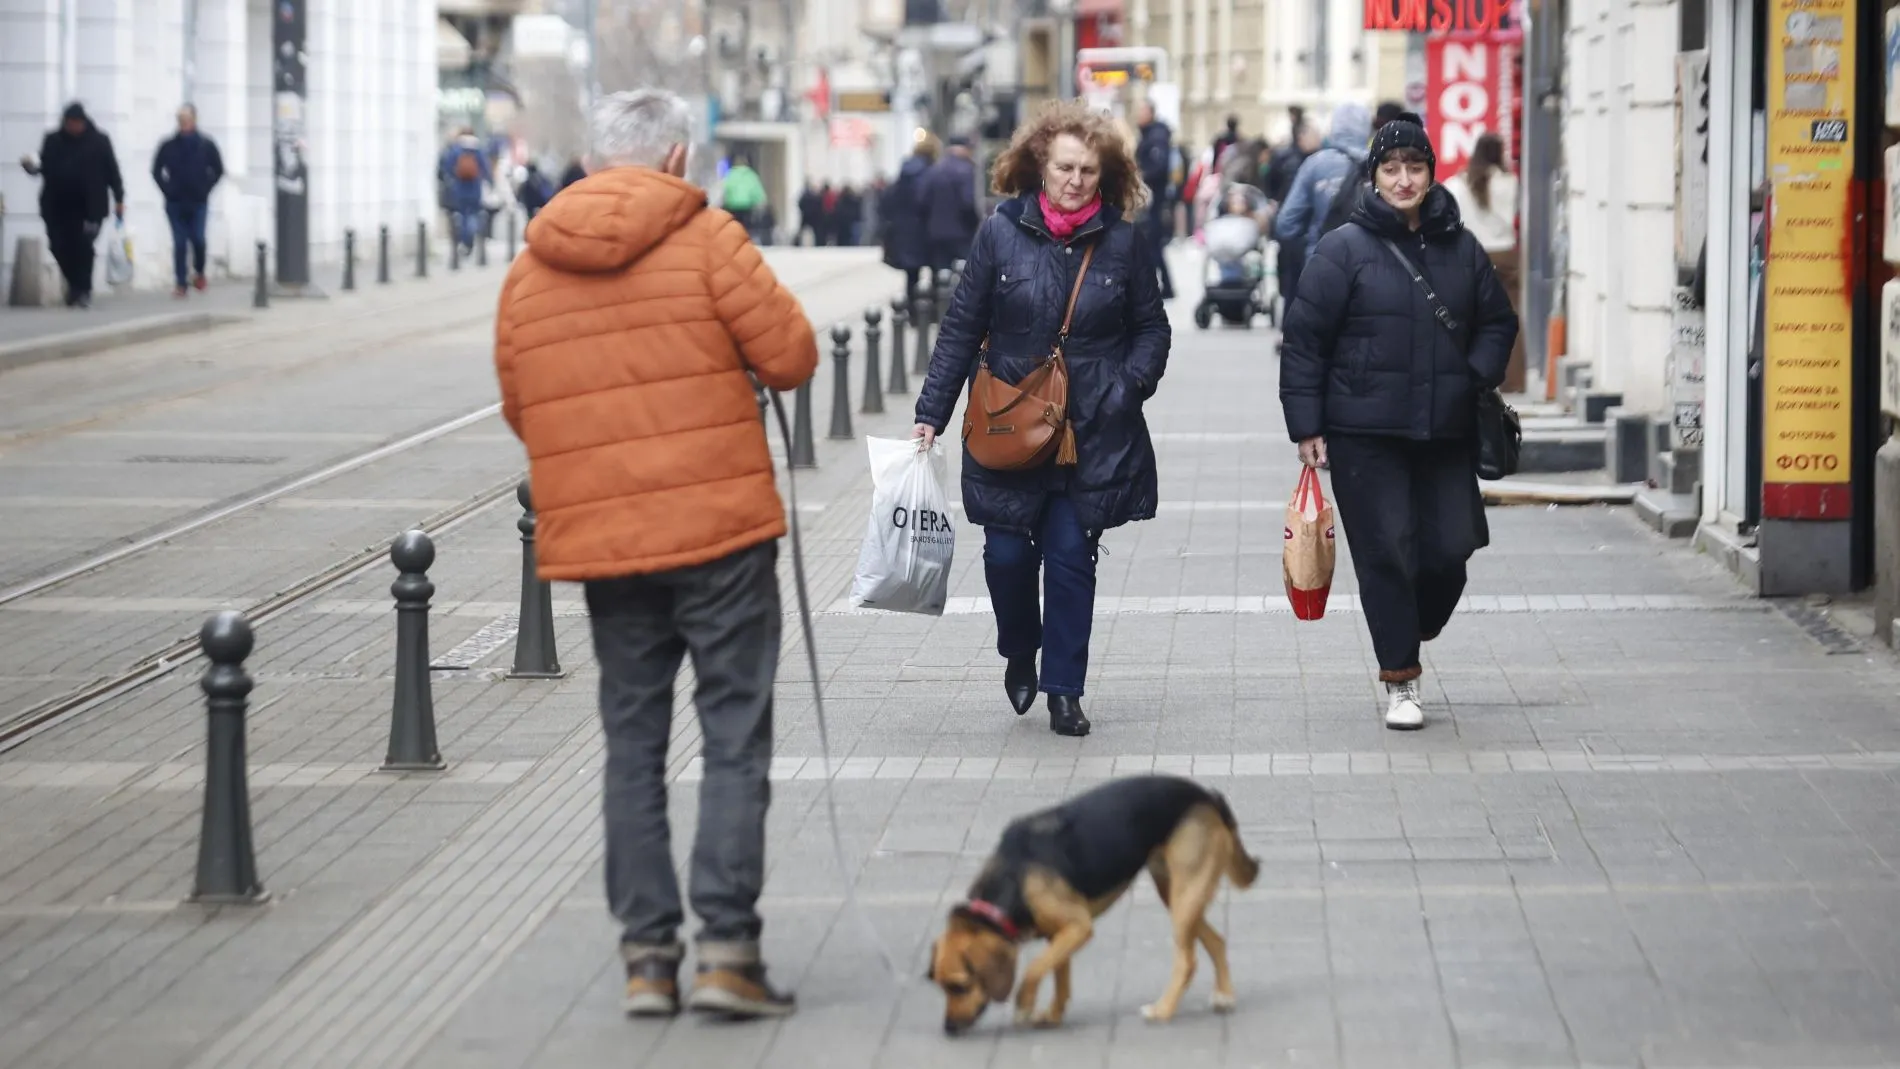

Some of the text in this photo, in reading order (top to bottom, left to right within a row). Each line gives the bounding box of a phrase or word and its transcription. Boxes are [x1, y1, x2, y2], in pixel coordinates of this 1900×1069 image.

[1364, 0, 1511, 35] NON STOP
[1776, 454, 1838, 471] ФОТО
